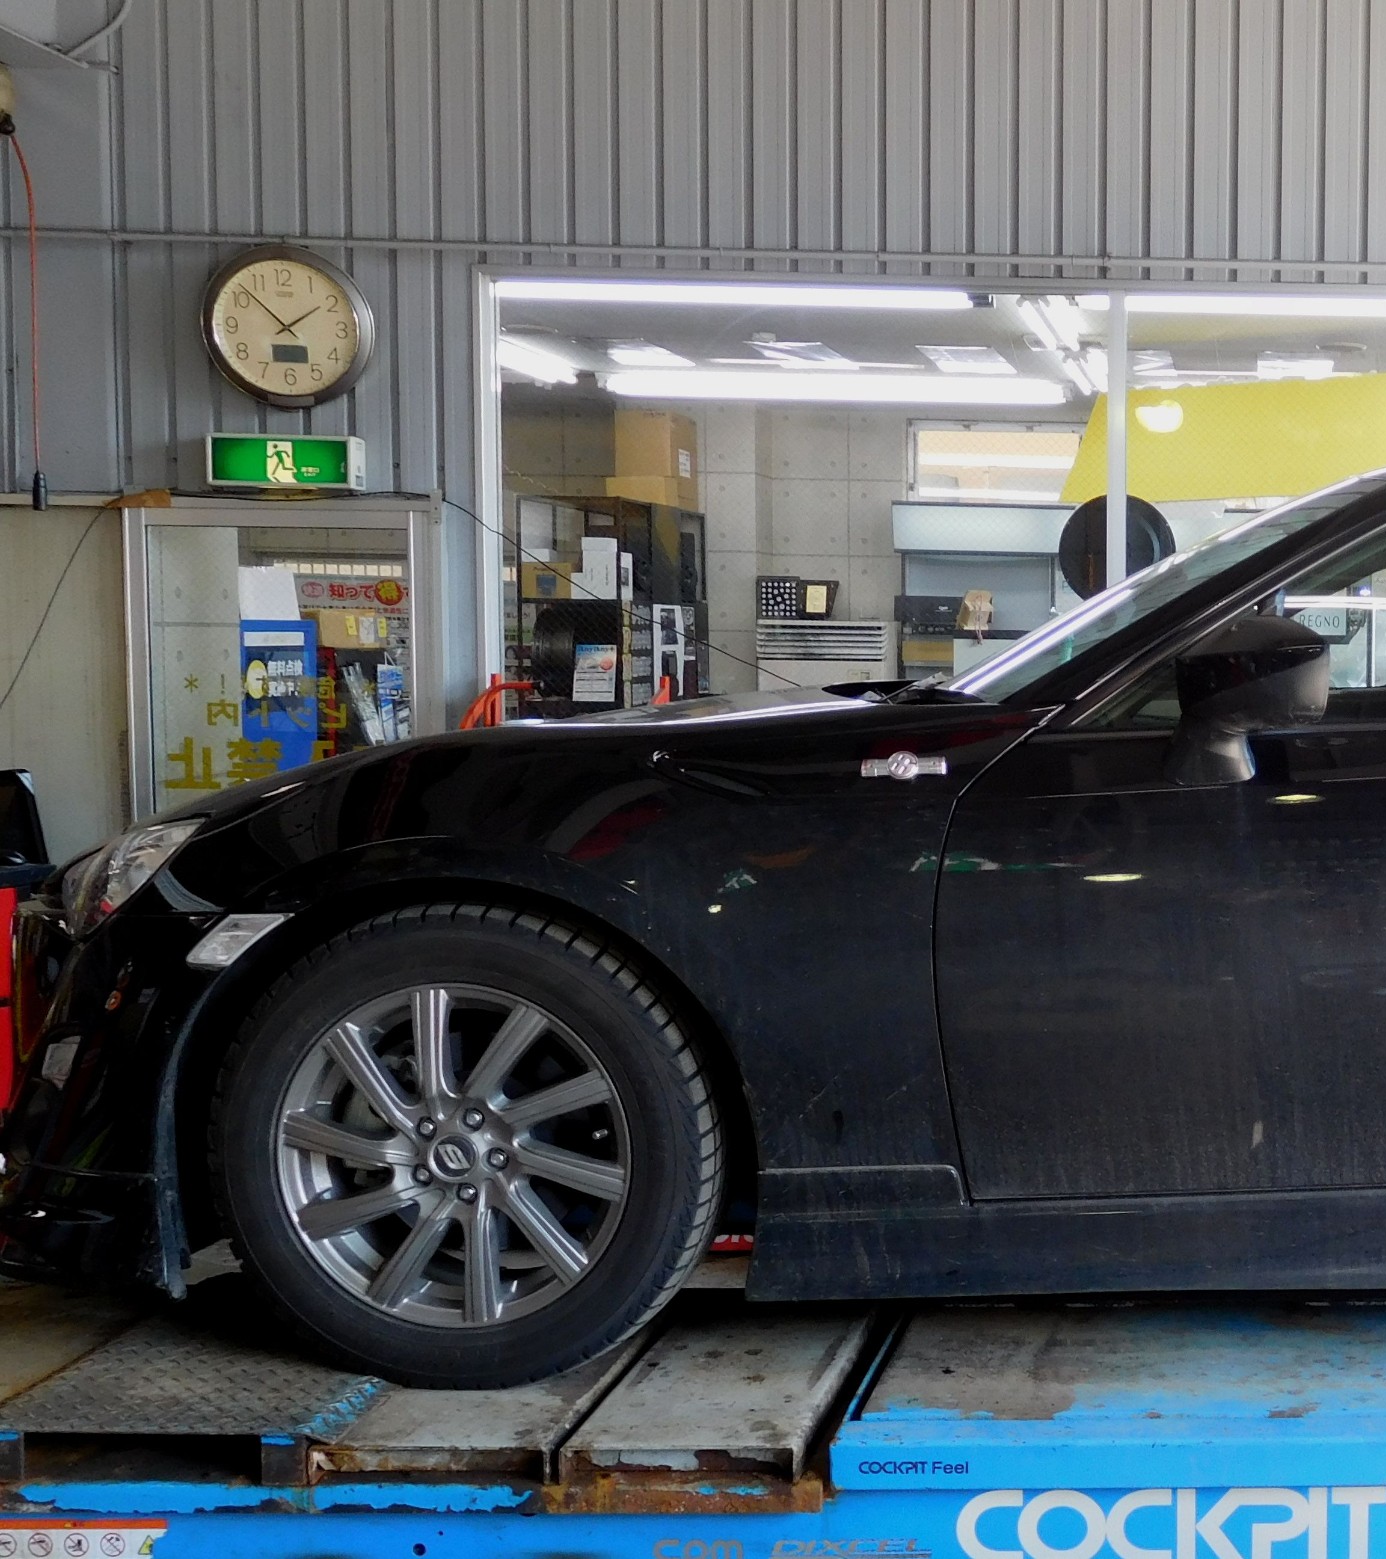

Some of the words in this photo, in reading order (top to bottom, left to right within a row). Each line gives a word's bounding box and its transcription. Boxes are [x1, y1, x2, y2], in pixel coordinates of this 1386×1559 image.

[252, 274, 265, 291] 11
[274, 269, 292, 287] 12
[232, 291, 250, 308] 10
[325, 295, 338, 312] 2
[226, 316, 239, 334] 9
[336, 321, 348, 339] 3
[236, 343, 249, 360] 8
[327, 348, 340, 364] 4
[258, 362, 269, 379] 7
[284, 368, 297, 386] 6
[310, 364, 323, 381] 5
[858, 1460, 928, 1475] COCKPIT
[931, 1460, 969, 1475] Feel
